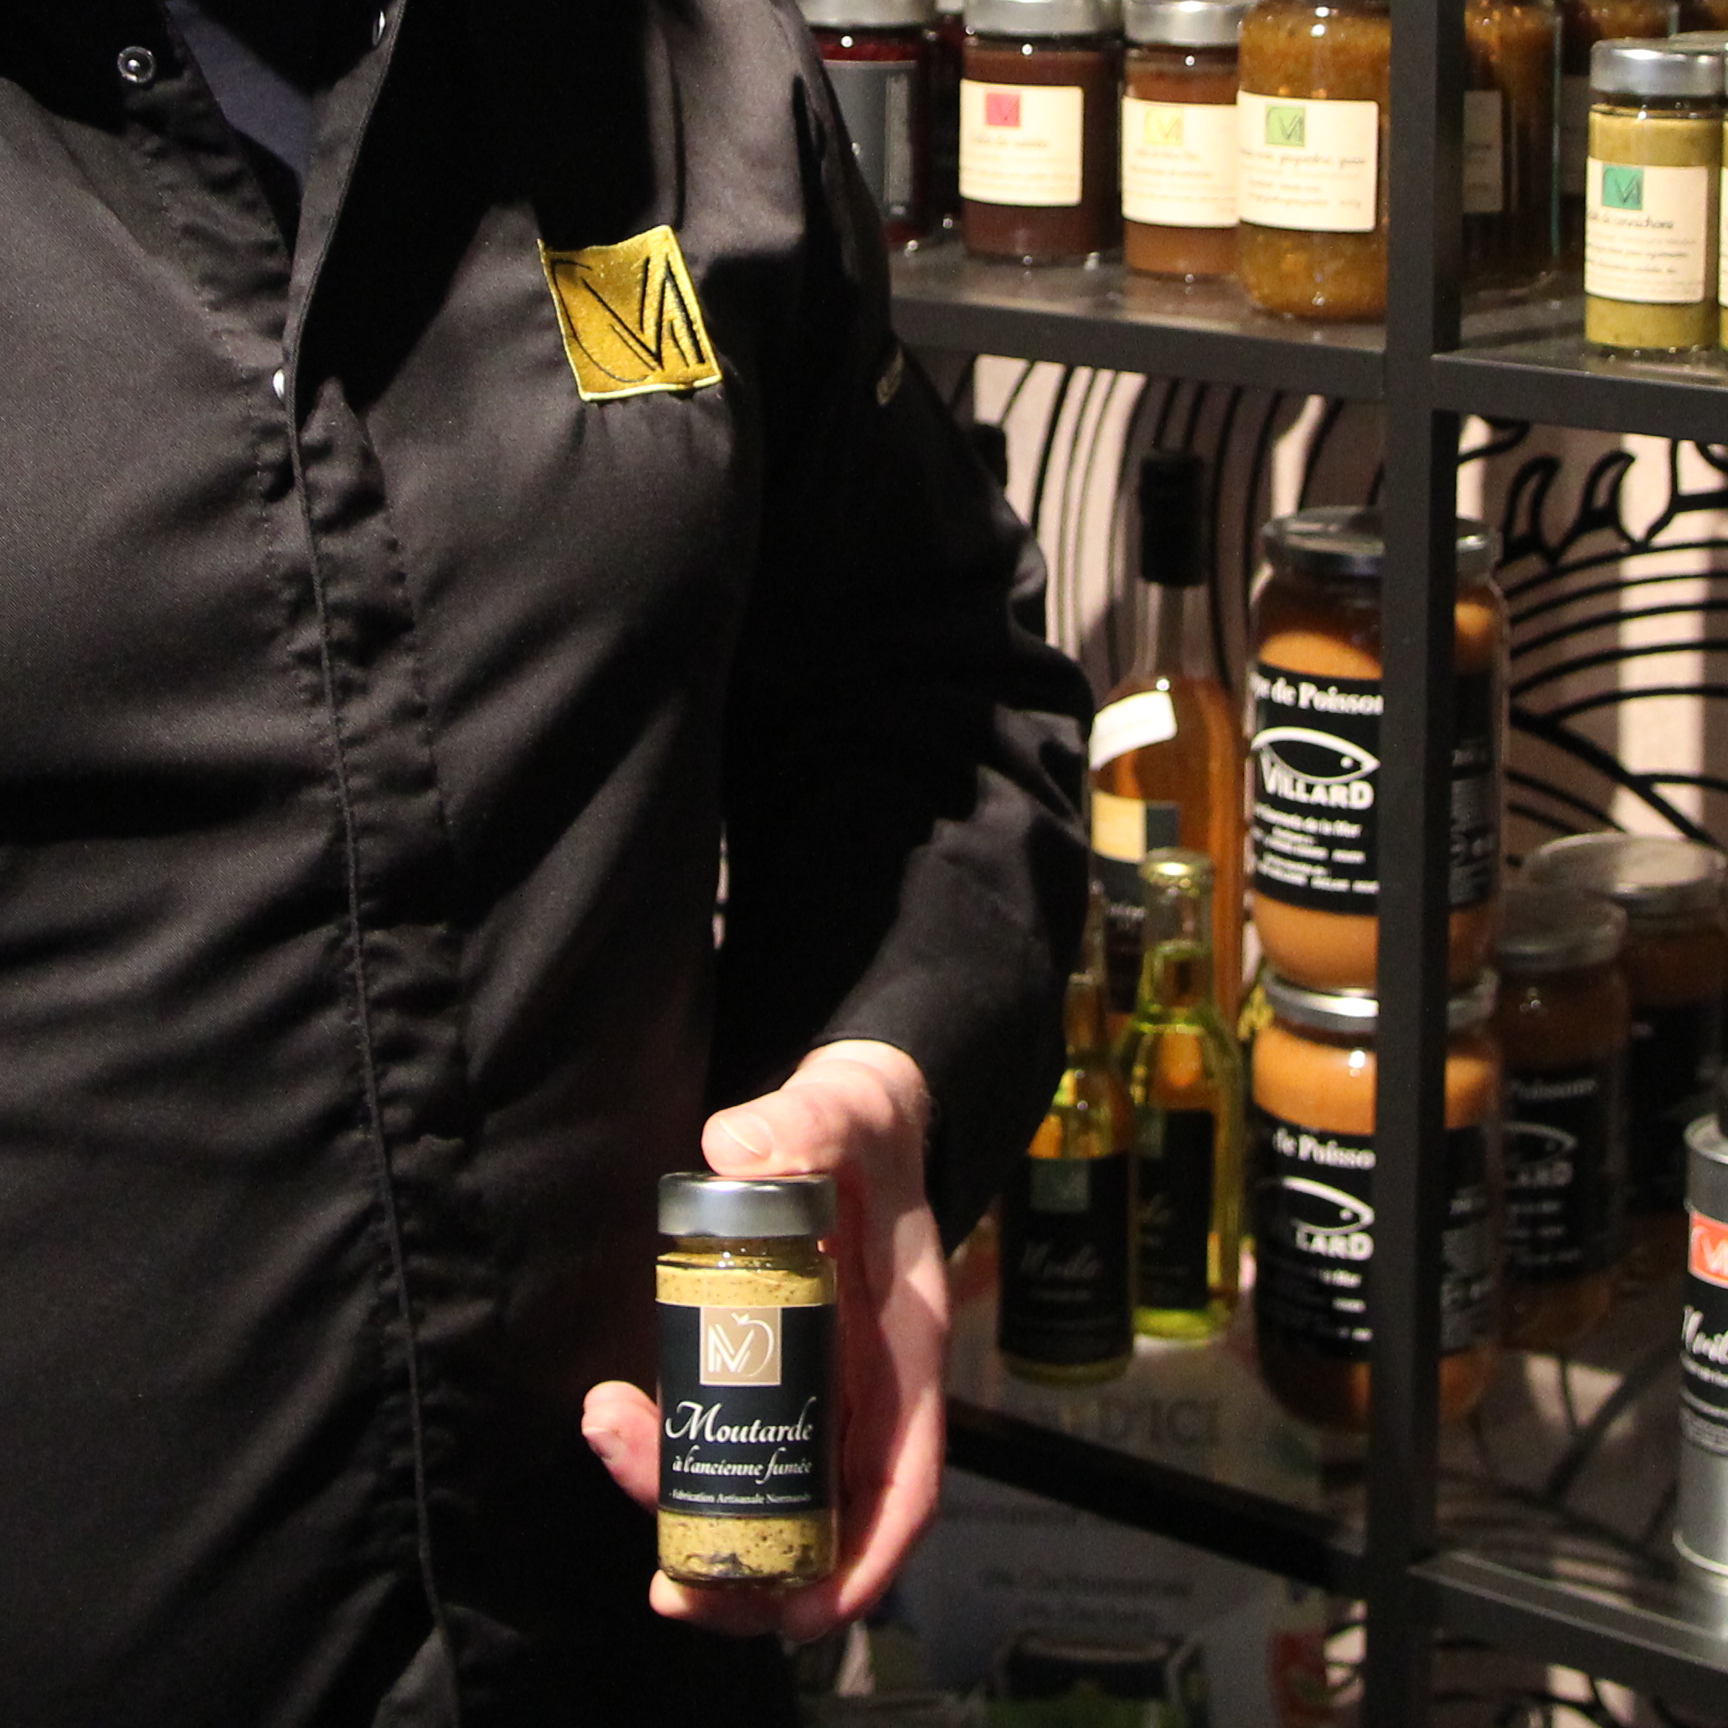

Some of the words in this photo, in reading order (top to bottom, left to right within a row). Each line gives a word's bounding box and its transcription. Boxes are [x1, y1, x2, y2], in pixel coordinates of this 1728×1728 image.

[1271, 677, 1298, 706] de
[1260, 748, 1375, 811] VILLARD
[665, 1395, 817, 1444] Moutarde
[672, 1455, 683, 1473] à
[683, 1445, 764, 1476] l'ancienne
[754, 1446, 814, 1485] fumée
